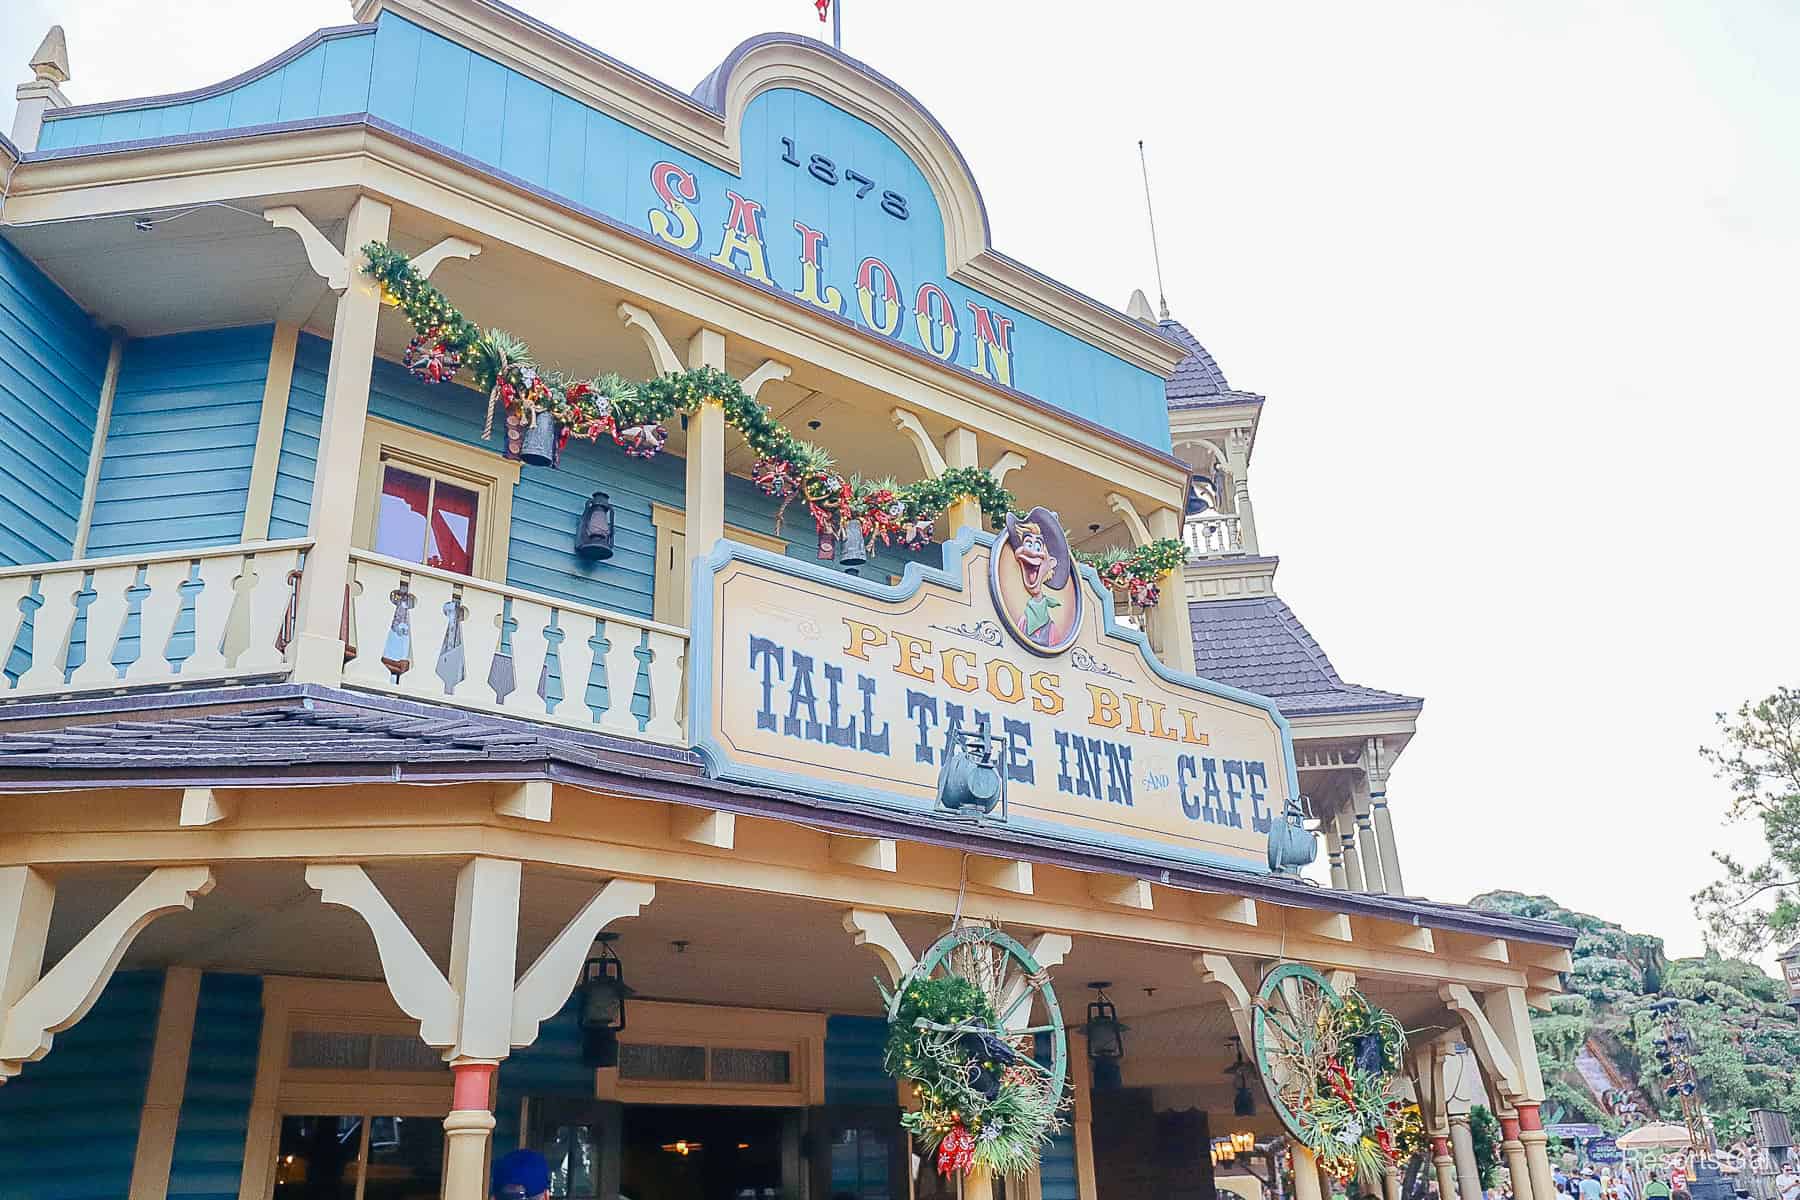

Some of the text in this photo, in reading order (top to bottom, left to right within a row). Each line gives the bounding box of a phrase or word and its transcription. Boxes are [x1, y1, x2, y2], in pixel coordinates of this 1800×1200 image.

[780, 136, 911, 221] 1878
[648, 160, 1016, 388] SALOON
[749, 632, 891, 757] TALL
[1054, 728, 1134, 808] INN
[1176, 751, 1273, 834] CAFE
[842, 616, 1210, 747] PECOS BILL
